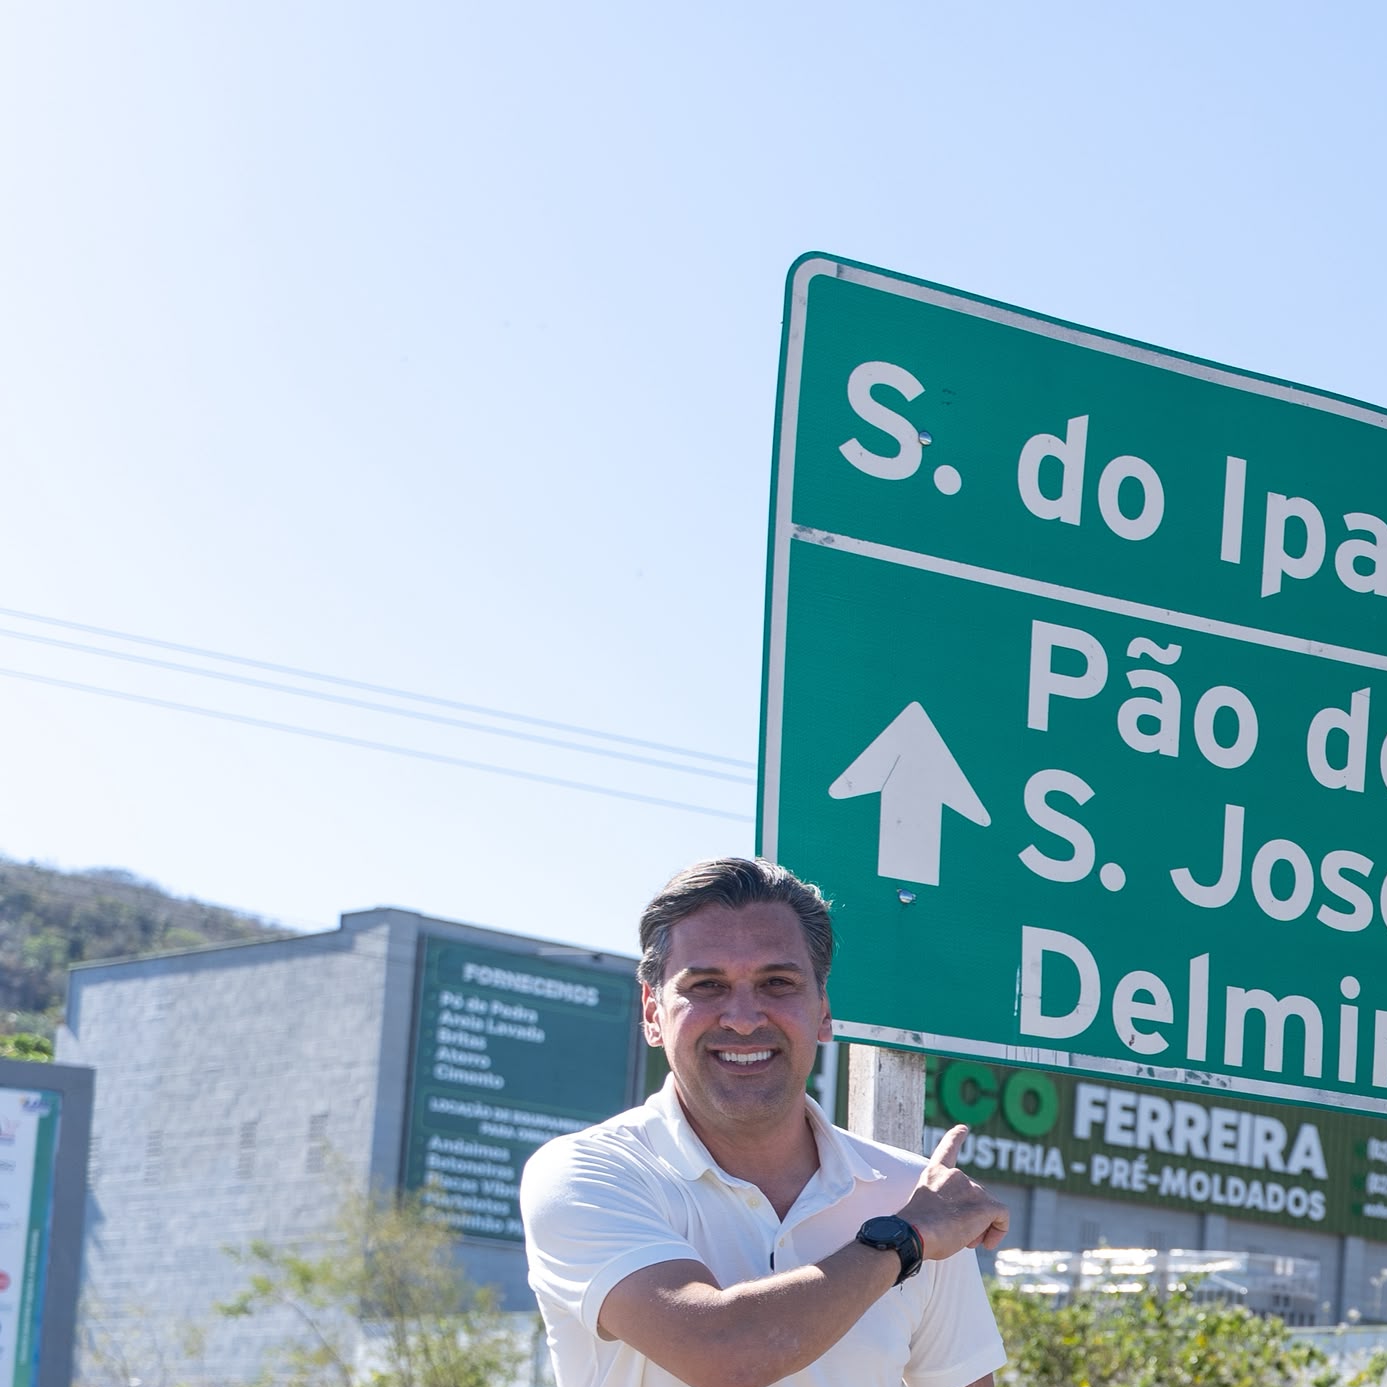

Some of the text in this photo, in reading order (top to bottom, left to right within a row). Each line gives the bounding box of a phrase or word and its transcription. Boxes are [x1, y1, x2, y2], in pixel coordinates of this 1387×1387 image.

[840, 362, 961, 494] S.
[1018, 415, 1164, 540] do
[1028, 620, 1259, 768] Pão
[1019, 769, 1127, 893] S.
[461, 961, 600, 1007] FORNECEMOS
[437, 1009, 546, 1044] Areia Lavada
[466, 995, 489, 1015] de
[489, 999, 539, 1025] Pedra
[436, 1026, 487, 1051] Britas
[433, 1062, 505, 1090] Cimento
[427, 1134, 511, 1163] Andaimes
[1074, 1082, 1329, 1180] FERREIRA
[425, 1152, 516, 1182] Betoneiras
[1090, 1153, 1327, 1222] PRÉ-MOLDADOS
